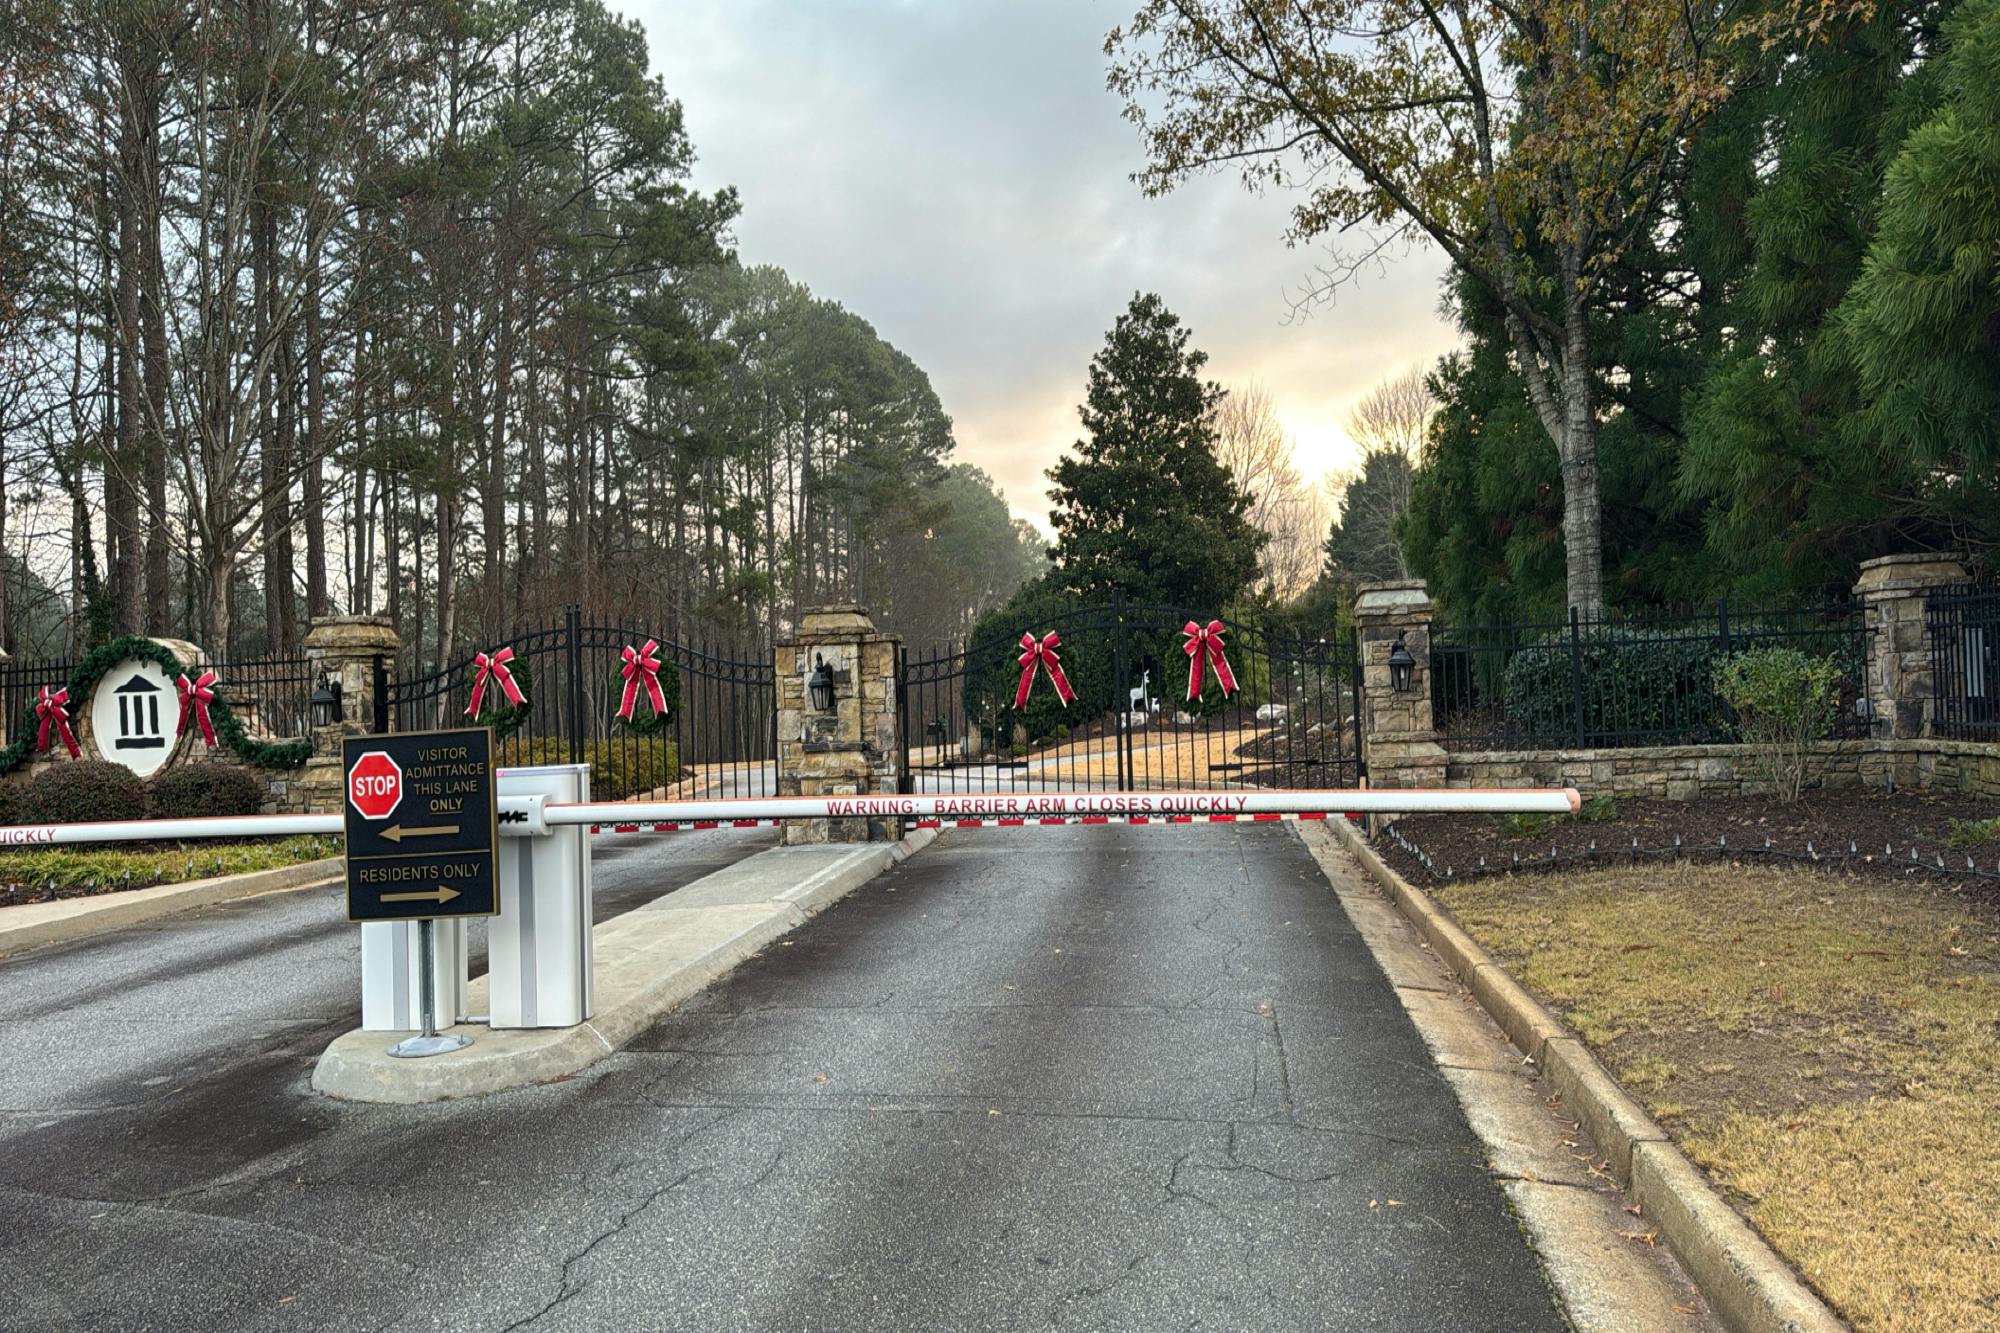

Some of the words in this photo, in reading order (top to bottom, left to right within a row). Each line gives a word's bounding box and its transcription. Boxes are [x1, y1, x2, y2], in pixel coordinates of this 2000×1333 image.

[418, 747, 467, 761] VISITOR
[406, 763, 485, 779] ADMITTANCE
[355, 775, 396, 797] STOP
[414, 782, 442, 795] THIS
[446, 780, 477, 793] LANE
[430, 798, 463, 812] ONLY
[827, 800, 920, 814] WARNING:
[934, 799, 1018, 813] BARRIER
[1026, 798, 1066, 812] ARM
[1074, 797, 1152, 812] CLOSES
[1160, 796, 1248, 812] QUICKLY
[360, 866, 439, 883] RESIDENTS
[443, 863, 481, 878] ONLY
